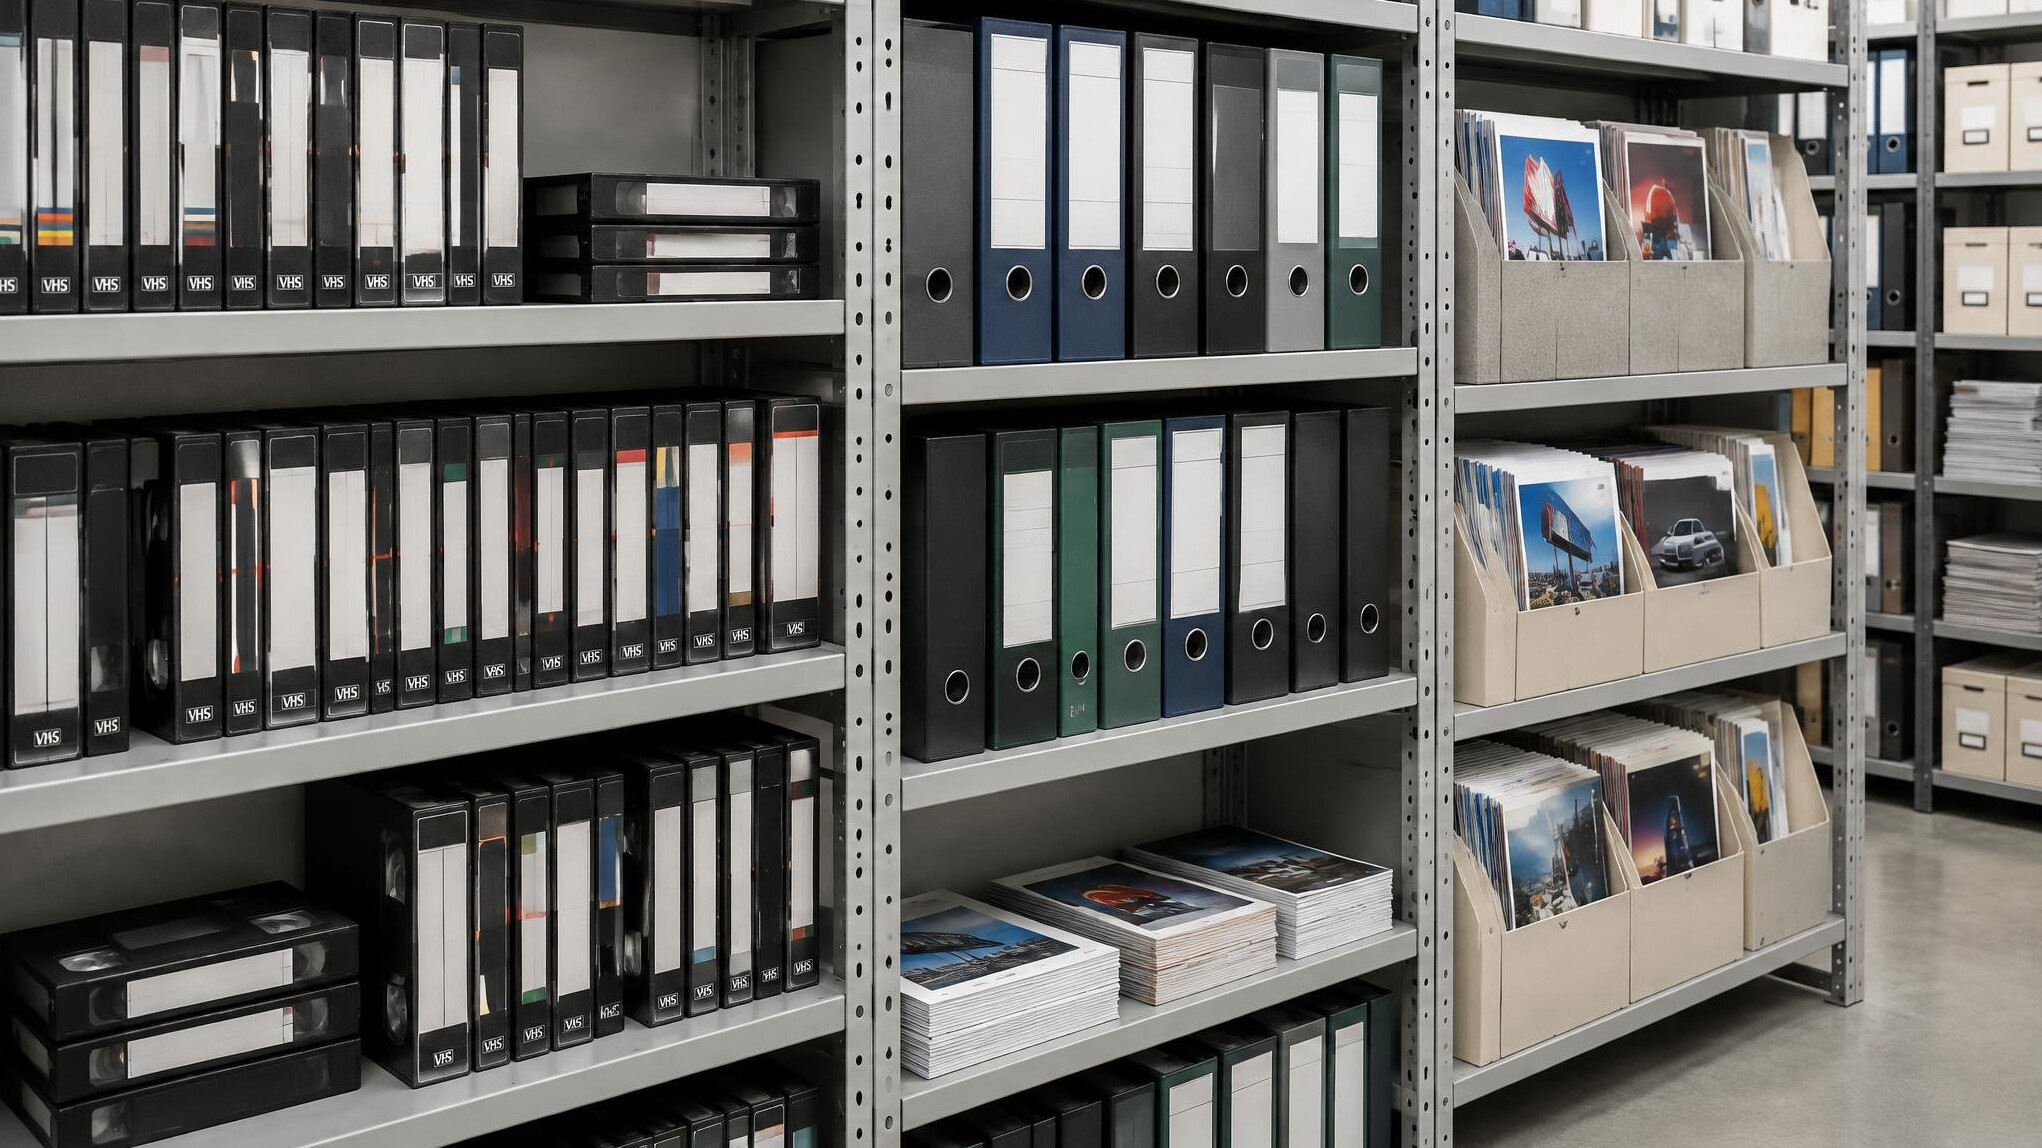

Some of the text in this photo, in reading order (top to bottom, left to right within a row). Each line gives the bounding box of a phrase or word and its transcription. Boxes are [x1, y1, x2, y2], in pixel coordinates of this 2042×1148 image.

[0, 279, 16, 291] HS
[43, 279, 68, 292] VHS
[94, 279, 119, 291] VHS
[143, 278, 167, 290] VHS
[189, 278, 212, 290] VHS
[279, 277, 302, 289] VHS
[323, 277, 344, 288] VHS
[367, 276, 388, 288] VHS
[493, 275, 513, 286] VHS
[660, 640, 676, 651] VHS
[696, 635, 713, 647] VHS
[582, 651, 600, 663] VHS
[624, 646, 642, 657] VHS
[408, 677, 428, 688] VHS
[446, 671, 465, 682] VHS
[337, 686, 358, 699] VHS
[235, 701, 255, 714] VHS
[283, 695, 304, 708] VHS
[188, 708, 211, 722] VHS
[96, 719, 118, 734] VHS
[795, 961, 811, 973] VHS
[732, 977, 747, 989] VHS
[659, 994, 677, 1007] VHS
[525, 1027, 543, 1040] VHS
[484, 1038, 502, 1051] VHS
[434, 1051, 452, 1066] VHS
